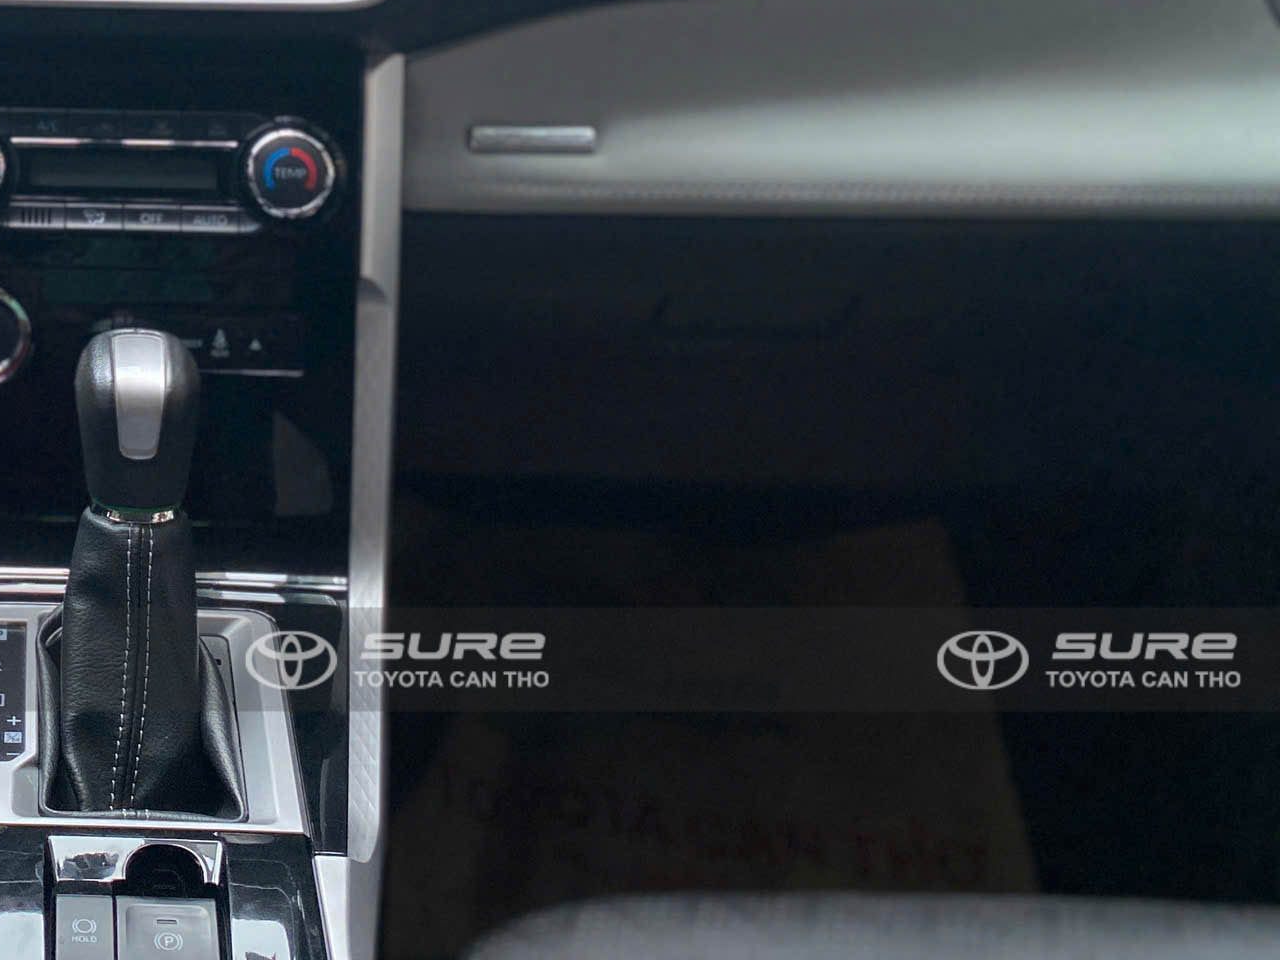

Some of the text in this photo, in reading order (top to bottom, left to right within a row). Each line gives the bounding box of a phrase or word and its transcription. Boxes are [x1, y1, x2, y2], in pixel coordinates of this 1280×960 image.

[273, 166, 308, 179] TEMP
[138, 211, 163, 225] OFF
[192, 213, 229, 226] AUTO
[71, 935, 97, 943] HOLD
